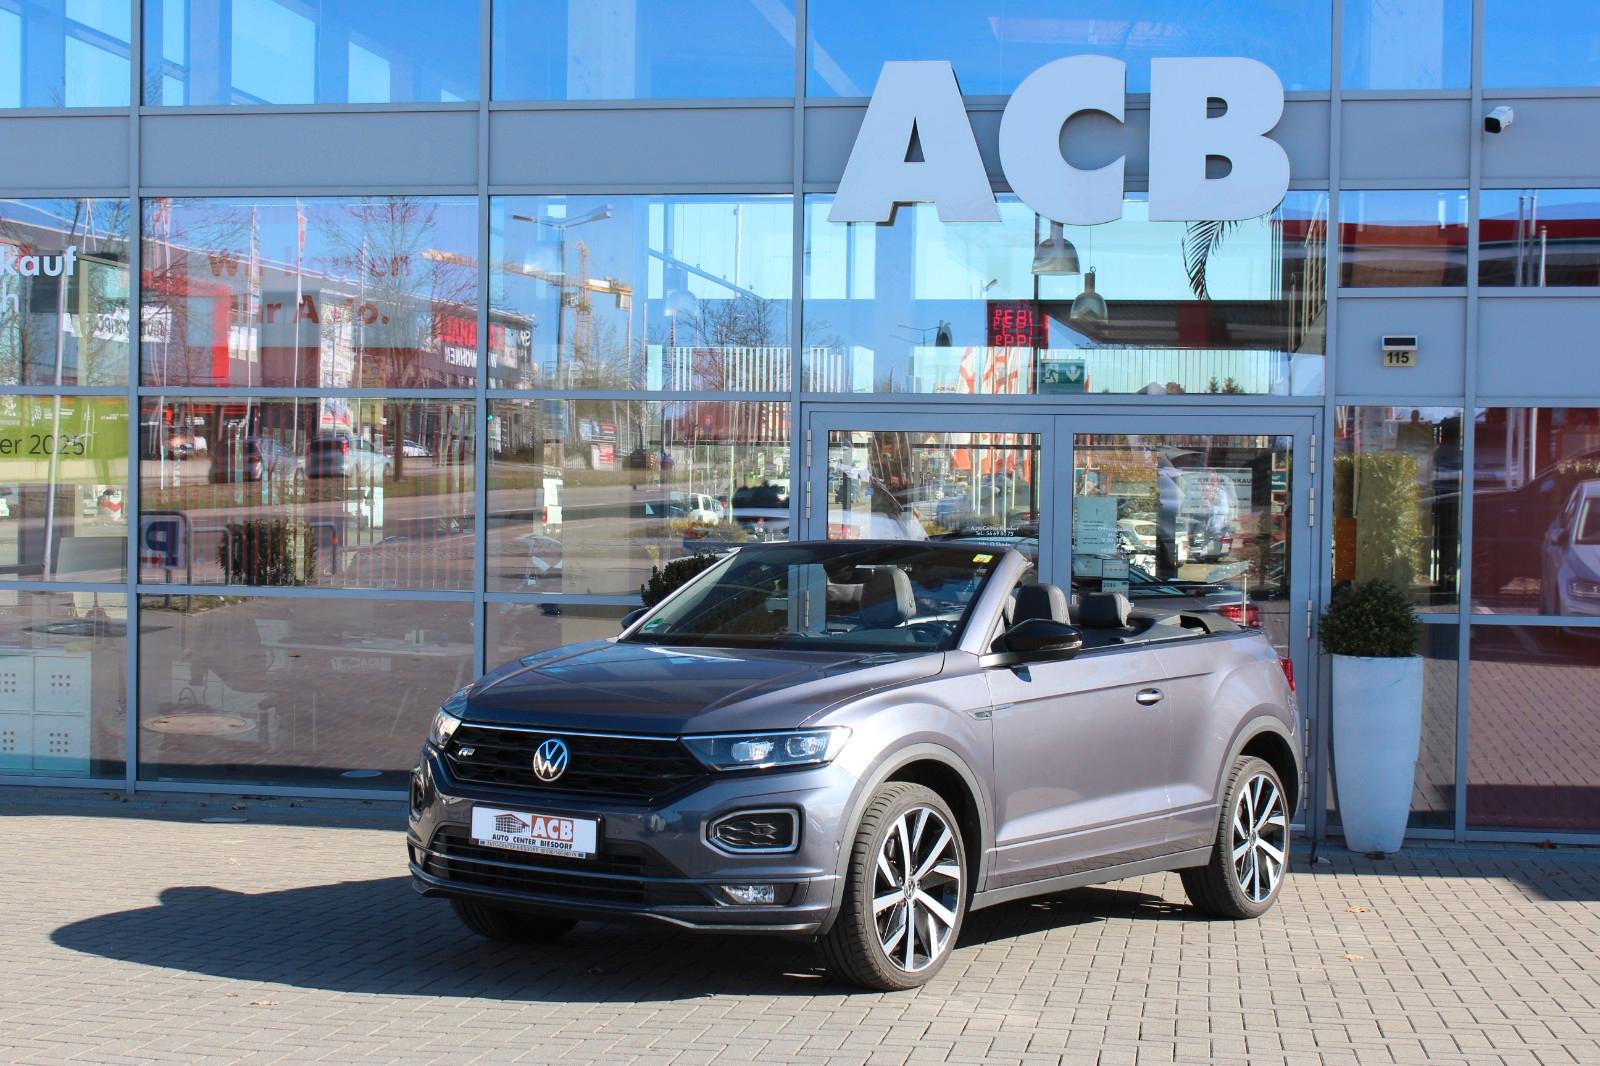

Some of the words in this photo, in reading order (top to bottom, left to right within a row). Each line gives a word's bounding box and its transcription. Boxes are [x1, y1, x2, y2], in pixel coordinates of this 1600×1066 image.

[828, 54, 1290, 225] ACB
[1386, 351, 1409, 364] 115
[531, 816, 573, 841] ACB
[492, 833, 509, 842] AUTO
[513, 836, 536, 845] CENTER
[540, 841, 573, 850] BIESDORF
